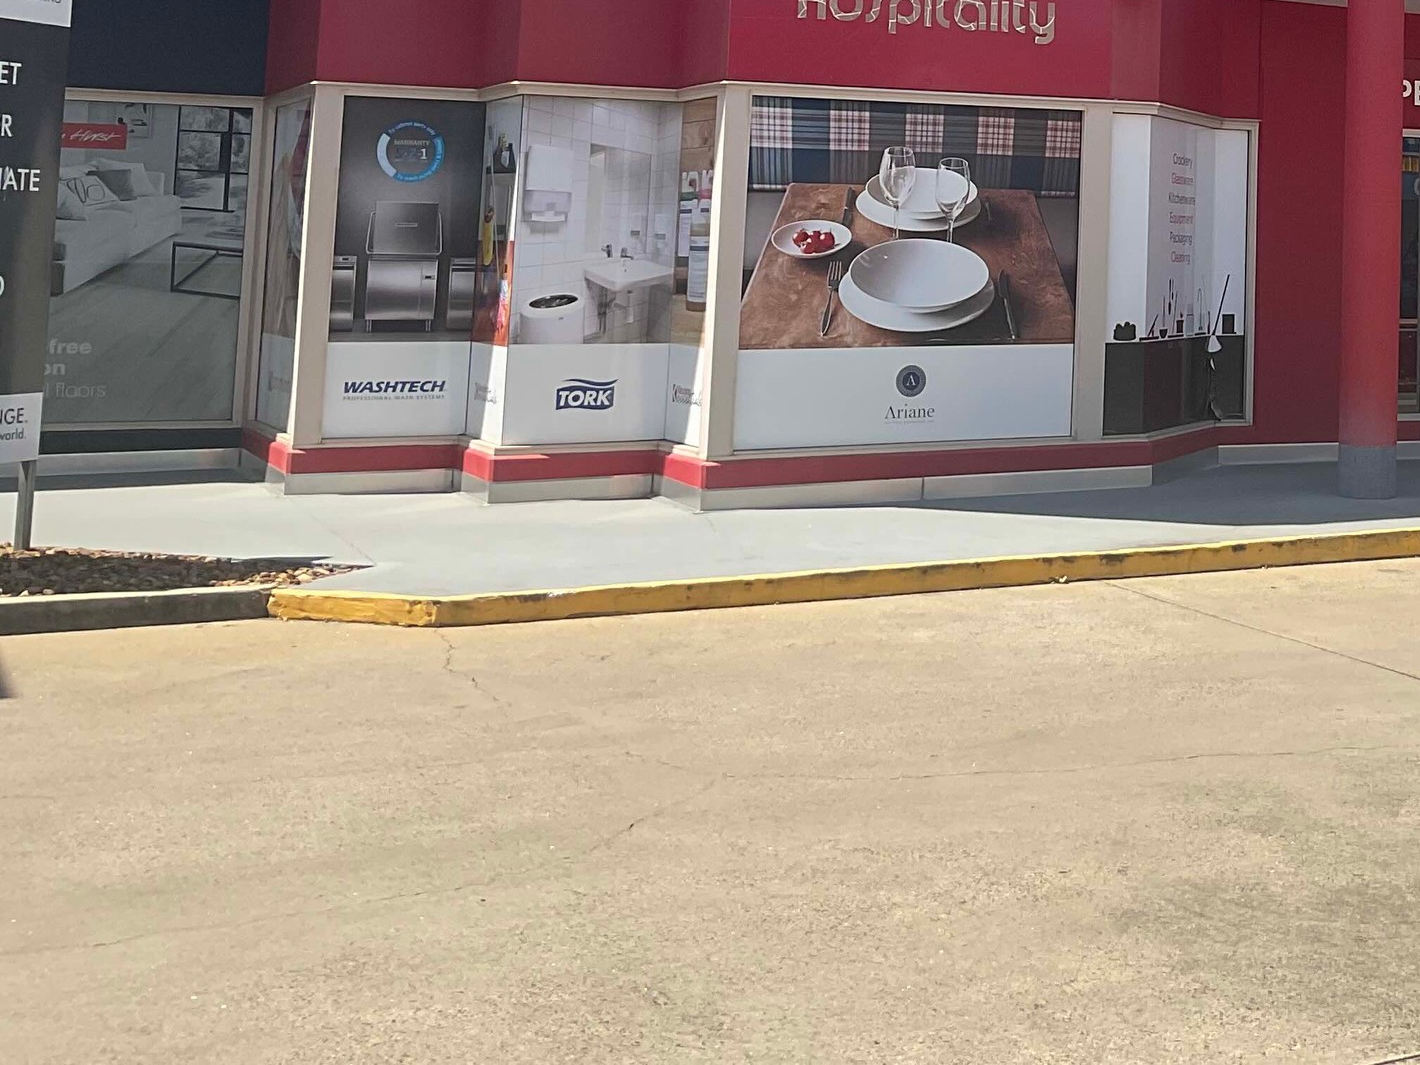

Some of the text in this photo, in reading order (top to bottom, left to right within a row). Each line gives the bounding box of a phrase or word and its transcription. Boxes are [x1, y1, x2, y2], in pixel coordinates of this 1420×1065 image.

[0, 167, 40, 191] ATE
[49, 338, 92, 354] free
[344, 380, 446, 394] WASHTECH
[559, 390, 612, 406] TORK
[885, 403, 935, 420] Ariane
